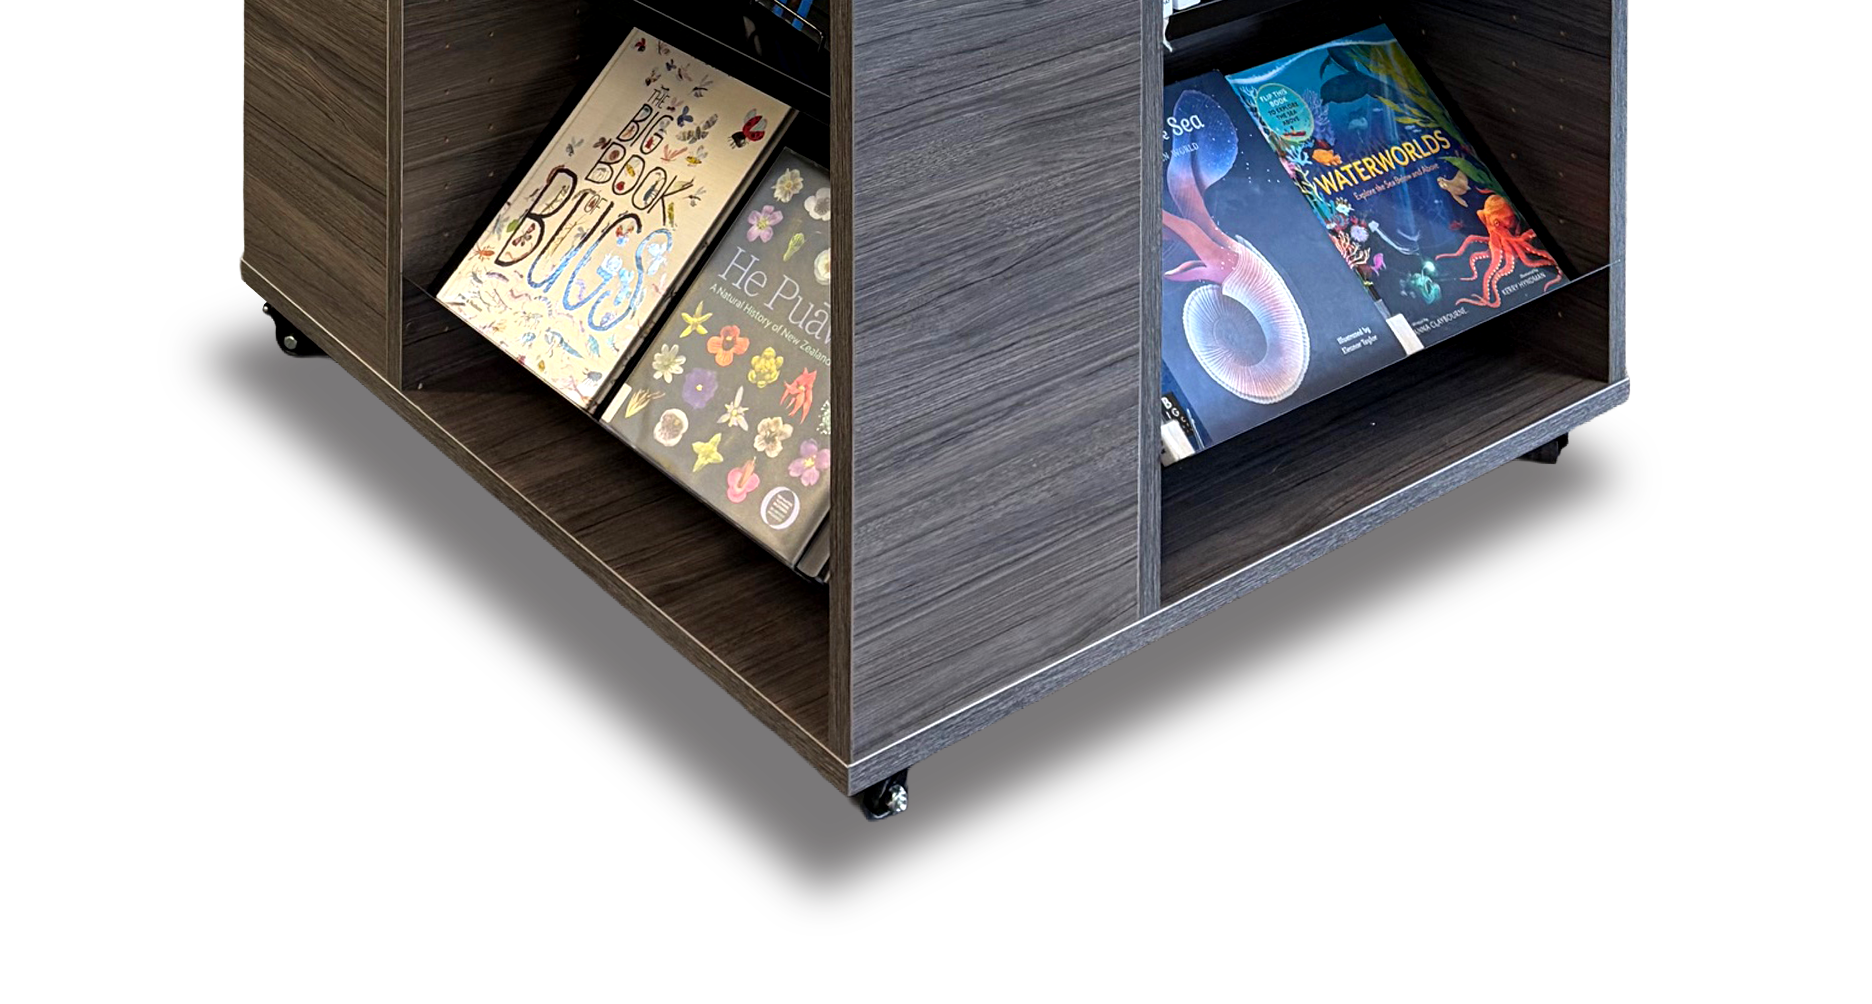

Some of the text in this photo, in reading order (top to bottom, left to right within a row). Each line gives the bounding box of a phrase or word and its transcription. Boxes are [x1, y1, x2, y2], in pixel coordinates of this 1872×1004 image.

[647, 88, 670, 110] THE
[1259, 88, 1288, 103] FLIP THIS
[1269, 97, 1289, 107] BOOK
[1267, 101, 1299, 117] TO EXPLORE
[1276, 109, 1298, 121] THE SEA
[616, 103, 674, 155] BIG
[1166, 114, 1205, 136] Sea
[1282, 116, 1300, 126] ABOVE
[1171, 141, 1200, 158] WORLD
[1312, 129, 1452, 196] WATERWORLDS
[584, 140, 694, 227] BOOK
[1353, 188, 1377, 202] Explore
[1374, 183, 1386, 192] the
[1384, 180, 1396, 189] Sea
[1411, 167, 1423, 178] and
[494, 166, 673, 332] BUGS
[717, 246, 830, 344] He Puā
[1501, 272, 1547, 296] KERRY HYNDMAN
[709, 283, 717, 292] A
[716, 286, 746, 311] Natural
[743, 302, 772, 329] History
[771, 322, 784, 334] of
[781, 327, 801, 346] New
[1430, 306, 1468, 329] CLAYBOURNE
[1336, 326, 1372, 345] Illustrated by
[1360, 335, 1378, 346] Taylor
